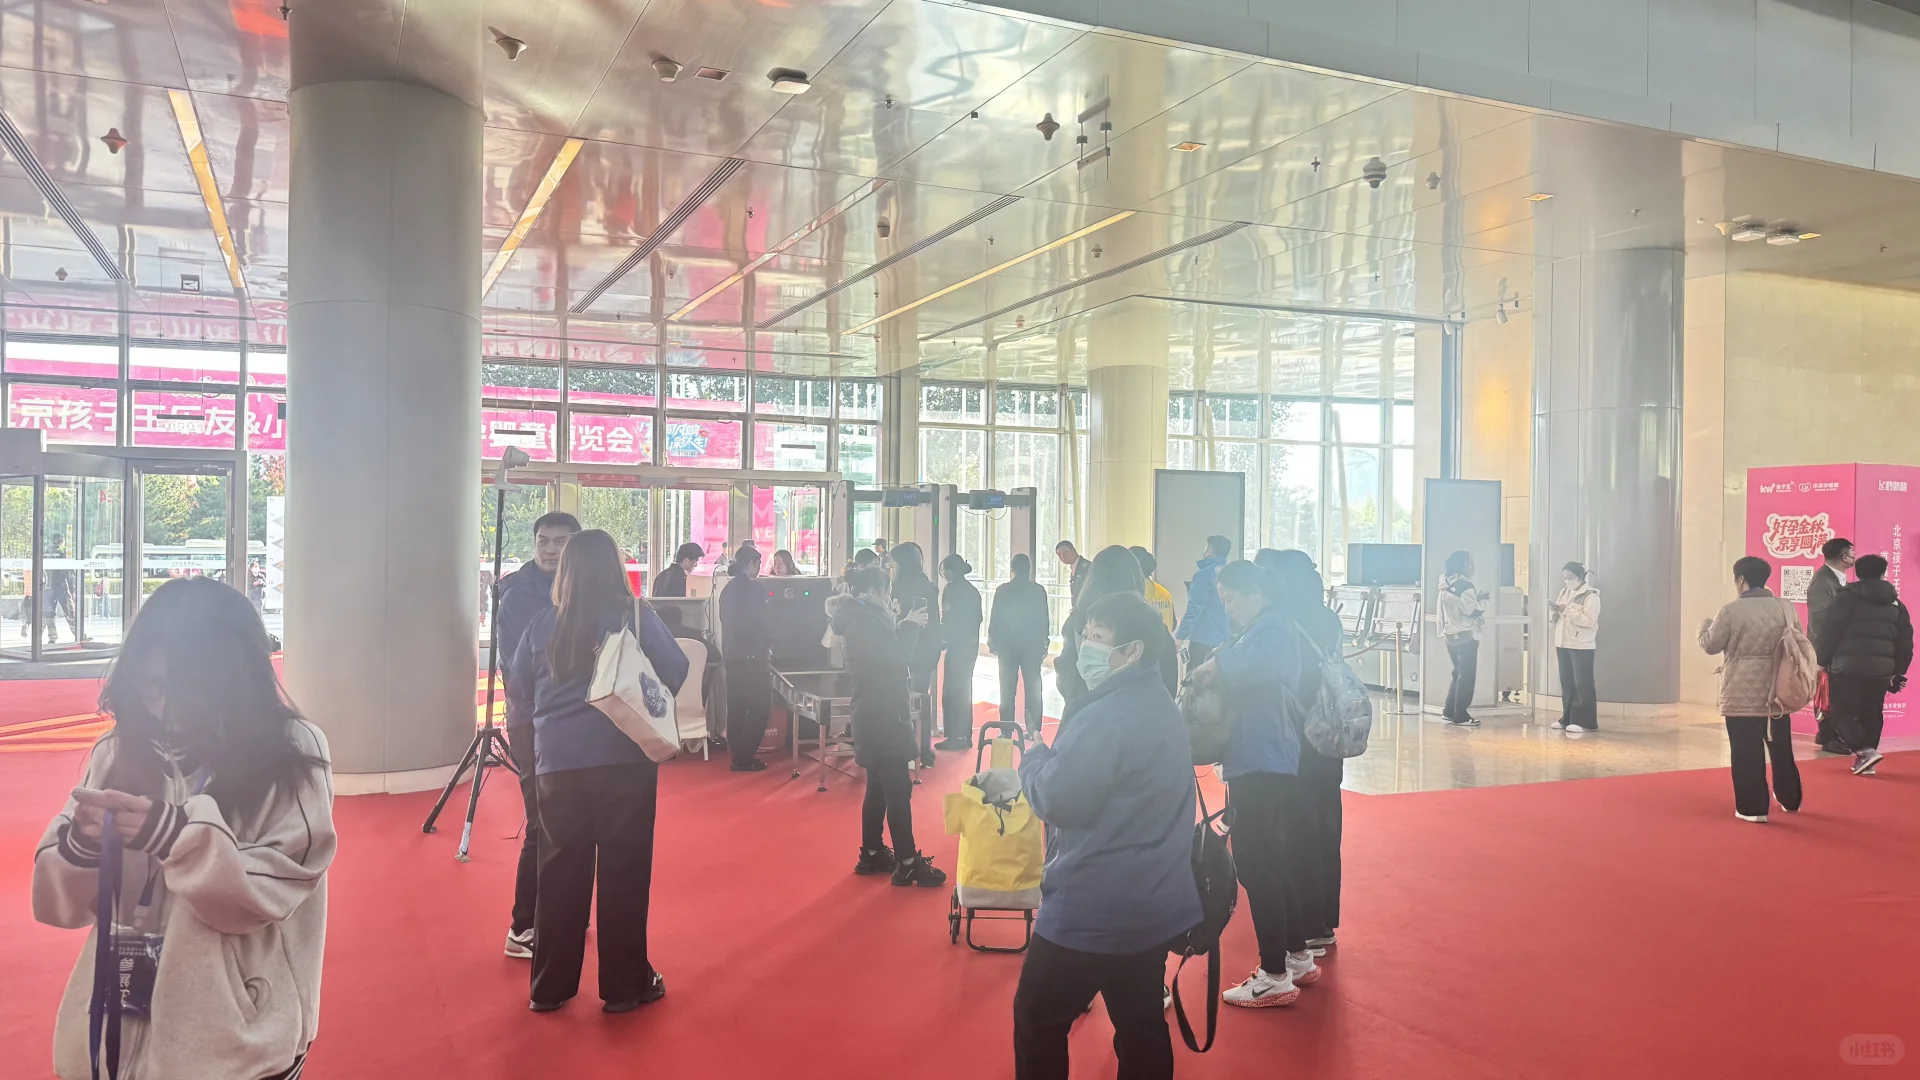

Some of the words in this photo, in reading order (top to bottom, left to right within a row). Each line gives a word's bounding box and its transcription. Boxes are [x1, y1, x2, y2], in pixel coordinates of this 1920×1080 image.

[1769, 518, 1825, 541] 好孕金秋
[1892, 524, 1901, 600] 北京孩子王
